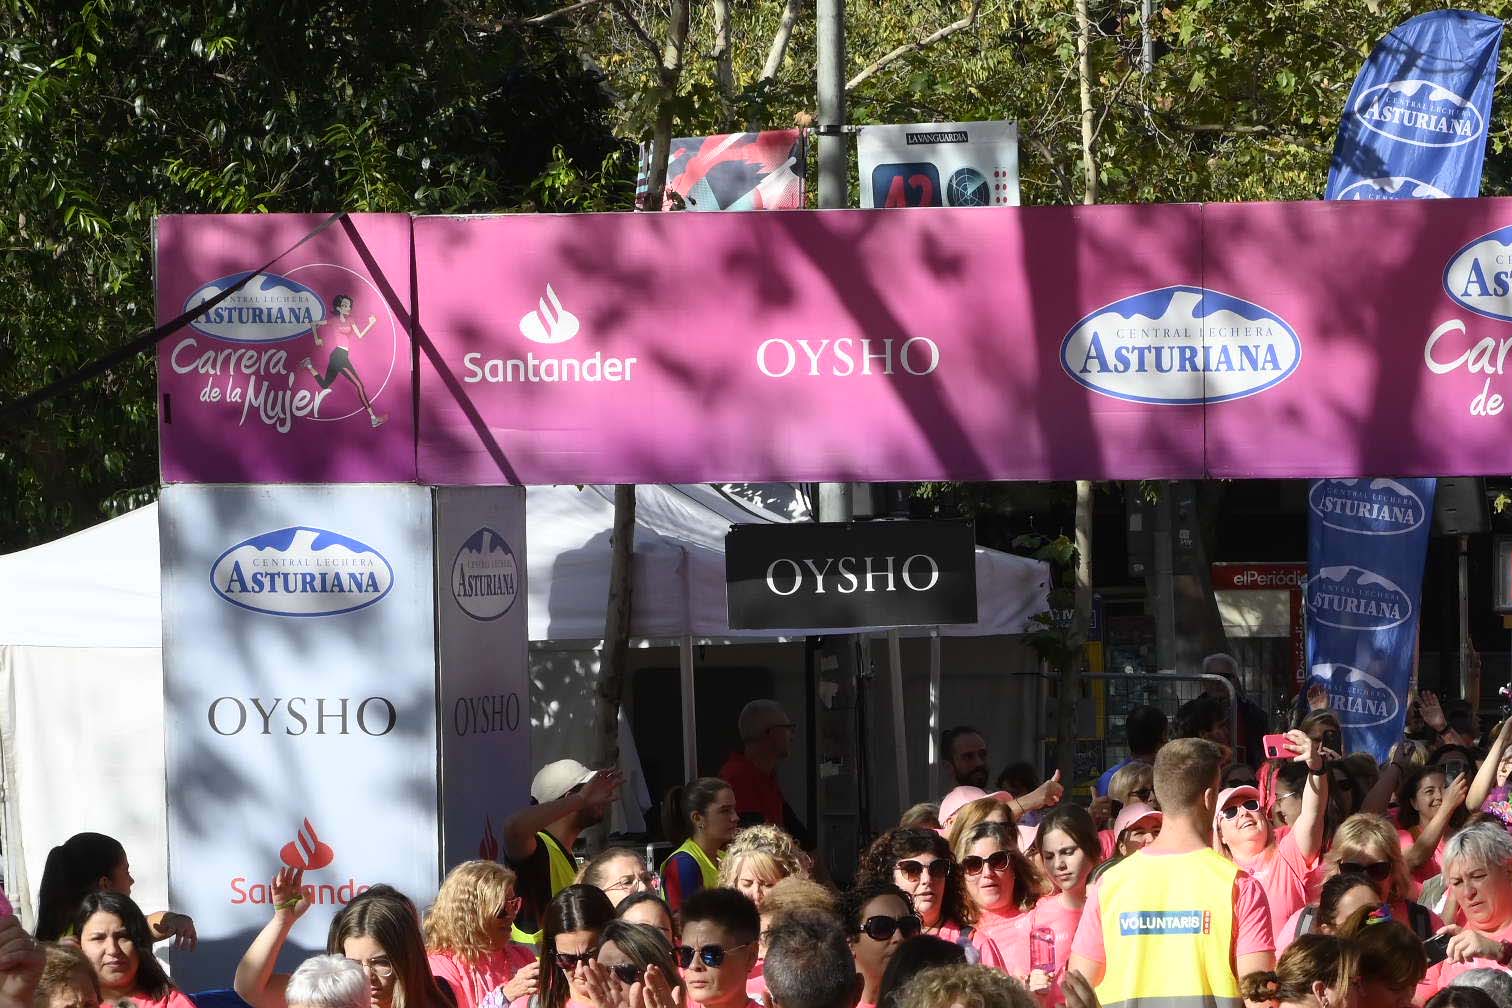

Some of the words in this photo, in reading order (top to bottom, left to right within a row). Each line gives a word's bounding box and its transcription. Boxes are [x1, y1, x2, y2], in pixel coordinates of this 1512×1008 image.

[1363, 96, 1473, 137] ASTURIANA
[1079, 331, 1283, 374] ASTURIANA
[1116, 327, 1192, 339] CENTRAL
[171, 338, 289, 376] Carrera
[463, 351, 638, 383] Santander
[755, 336, 940, 378] OYSHO
[200, 376, 222, 403] de
[226, 375, 242, 403] la
[239, 372, 333, 434] Mujer
[1469, 377, 1505, 416] de
[224, 559, 381, 594] ASTURIANA
[251, 558, 309, 567] CENTRAL
[315, 557, 375, 567] LECHERA
[457, 560, 515, 598] ASTURIANA
[765, 553, 940, 597] OYSHO
[207, 695, 398, 738] OYSHO
[454, 692, 521, 738] OYSHO
[1120, 915, 1200, 930] VOLUNTARIS
